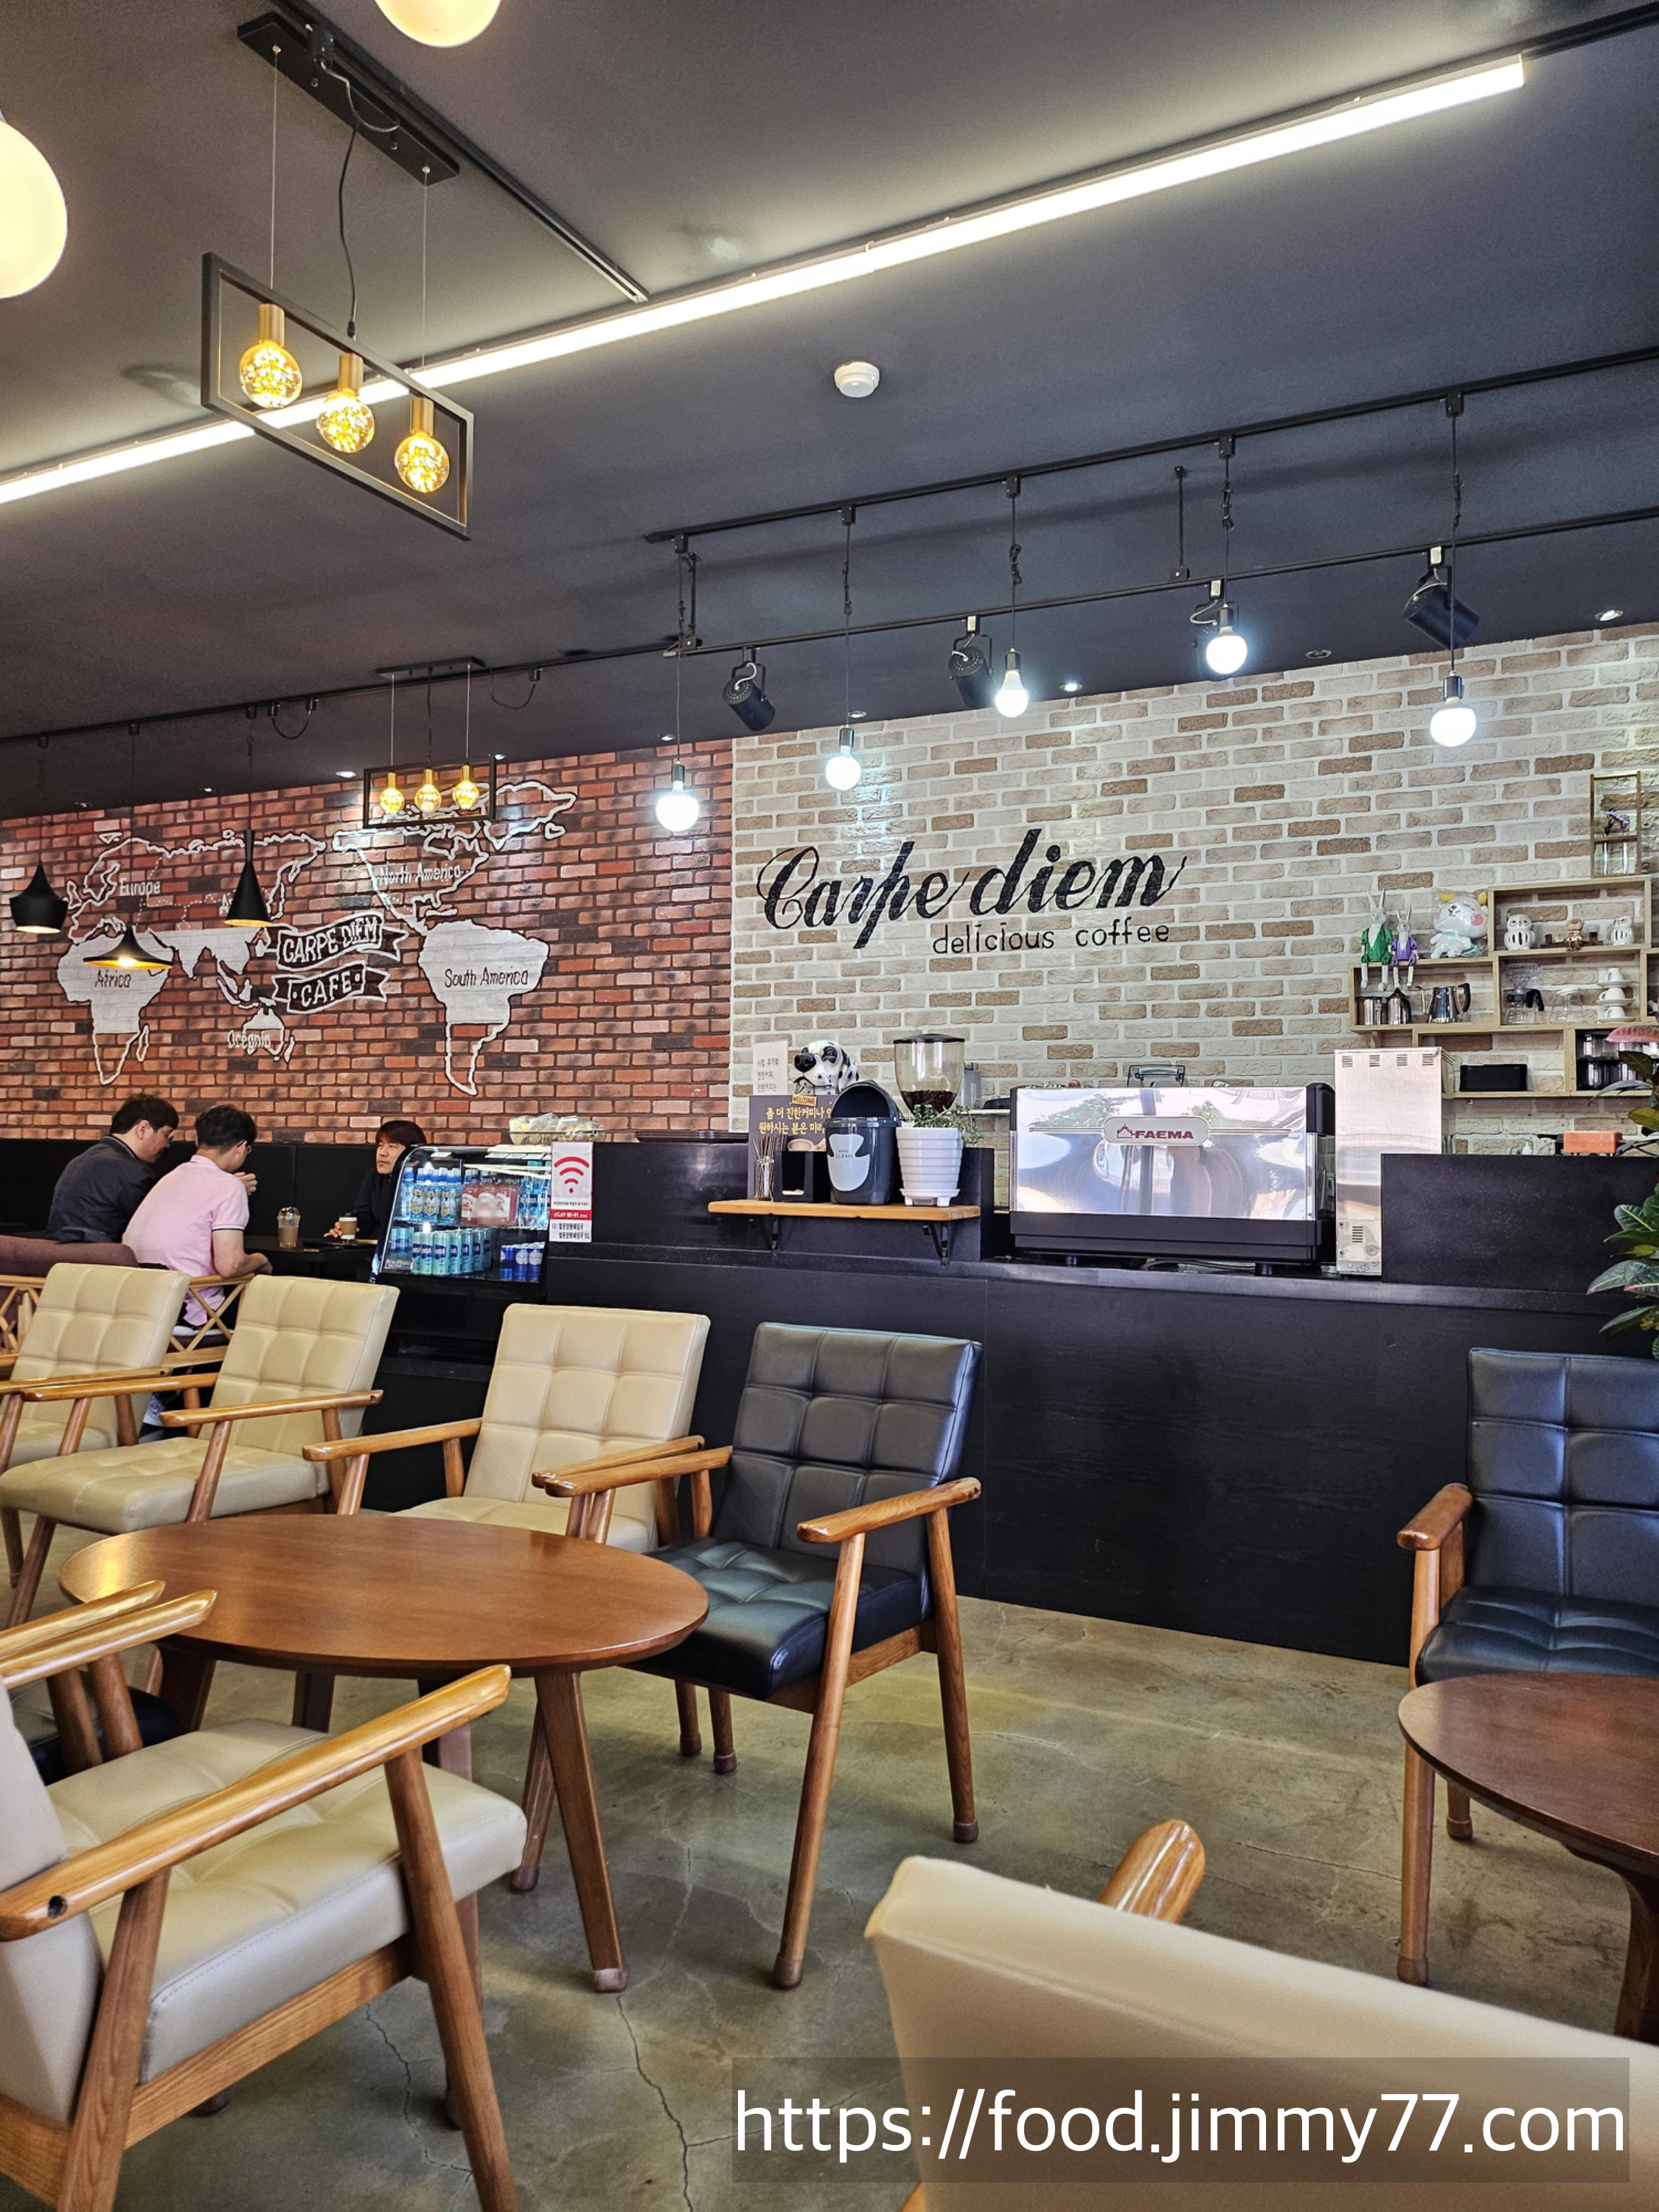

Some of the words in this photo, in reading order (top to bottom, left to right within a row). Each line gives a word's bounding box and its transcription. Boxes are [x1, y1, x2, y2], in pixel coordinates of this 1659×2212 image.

[379, 865, 412, 886] North
[417, 862, 462, 883] America
[119, 880, 161, 897] Europe
[757, 841, 970, 950] Carpe
[968, 828, 1187, 916] diem
[282, 931, 339, 964] CARPE
[341, 919, 380, 947] DIEM
[933, 923, 1054, 955] delicious
[1076, 917, 1169, 947] coffee
[94, 970, 132, 989] Africa
[444, 968, 476, 988] South
[479, 966, 529, 986] America
[765, 1107, 775, 1120] 좀
[776, 1107, 784, 1119] 더
[758, 1121, 790, 1135] 원하시는
[791, 1121, 808, 1135] 분은
[1135, 1130, 1194, 1139] FAEMA
